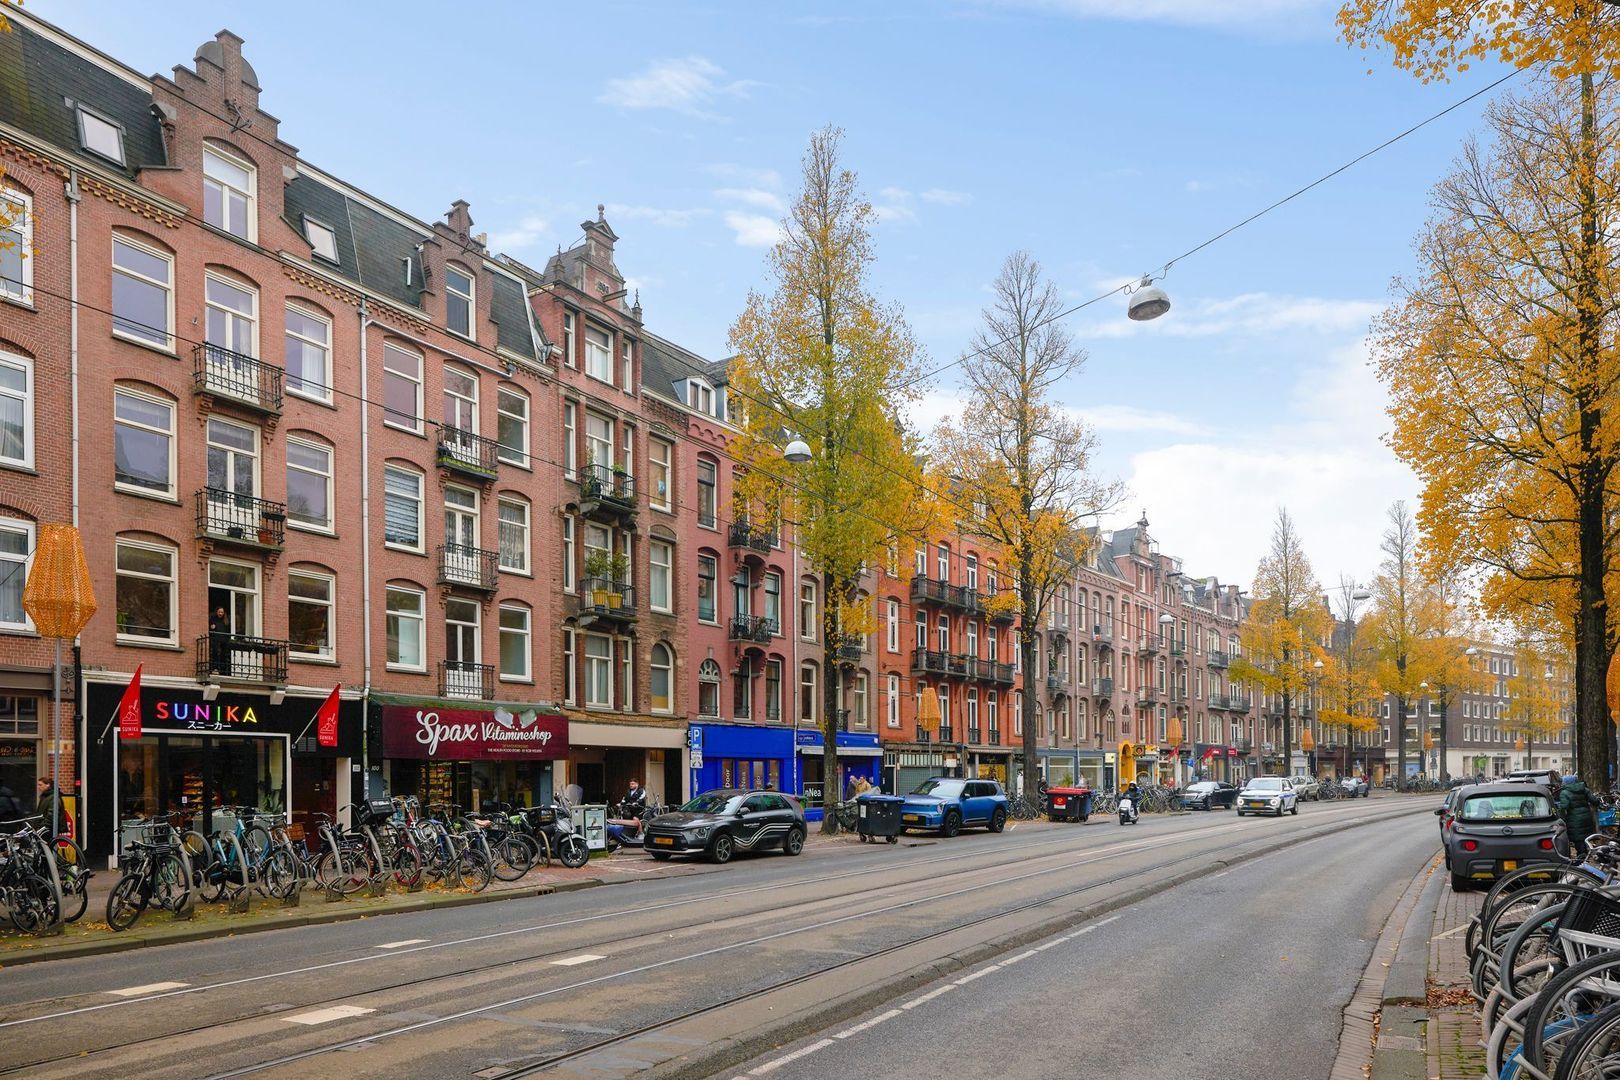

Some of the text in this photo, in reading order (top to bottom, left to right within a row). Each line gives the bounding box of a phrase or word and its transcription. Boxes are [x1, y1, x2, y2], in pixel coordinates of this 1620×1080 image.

[156, 701, 258, 723] SUNIKA
[187, 720, 232, 730] スニーカー
[415, 710, 552, 756] Spax Vitamineshop
[693, 729, 700, 741] P
